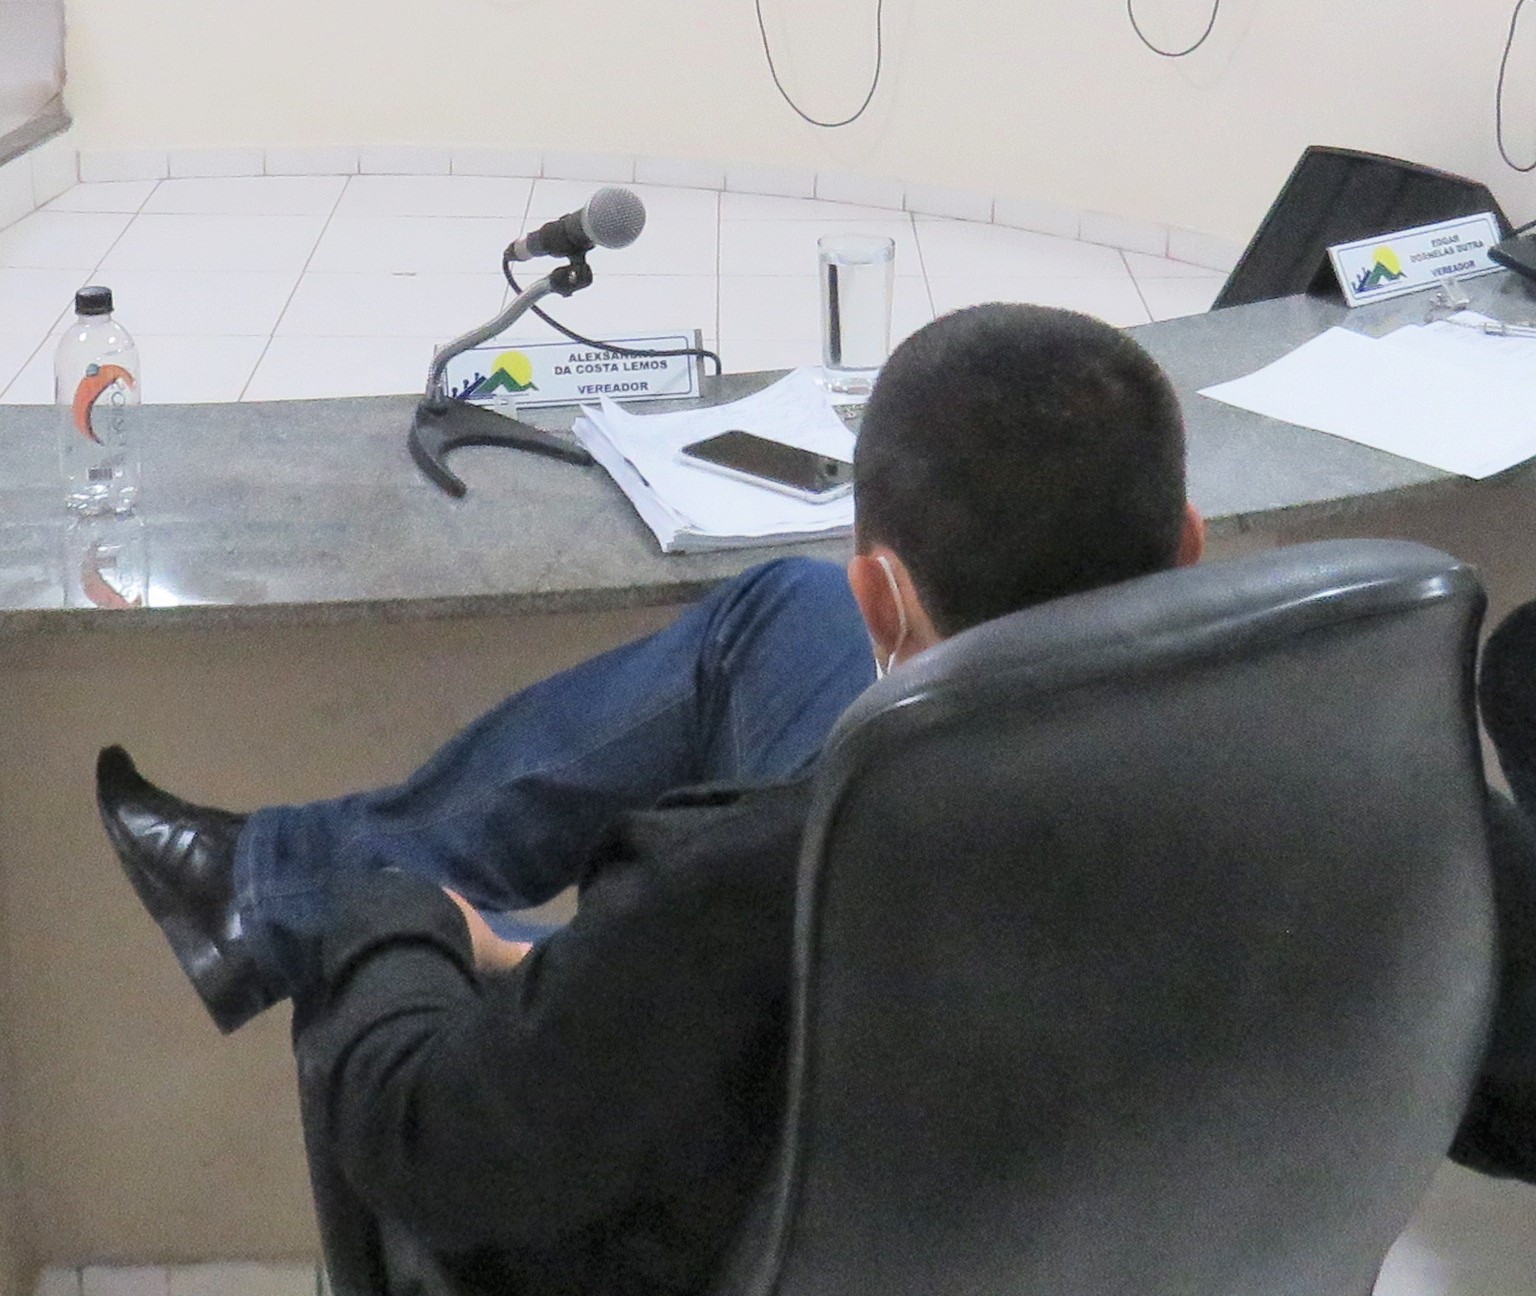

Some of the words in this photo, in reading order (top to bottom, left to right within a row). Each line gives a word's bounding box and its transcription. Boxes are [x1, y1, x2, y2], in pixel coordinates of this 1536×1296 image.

[1431, 260, 1476, 276] VEREADOR
[554, 366, 572, 375] DA
[576, 363, 619, 374] COSTA
[624, 360, 668, 371] LEMOS
[577, 382, 649, 394] VEREADOR
